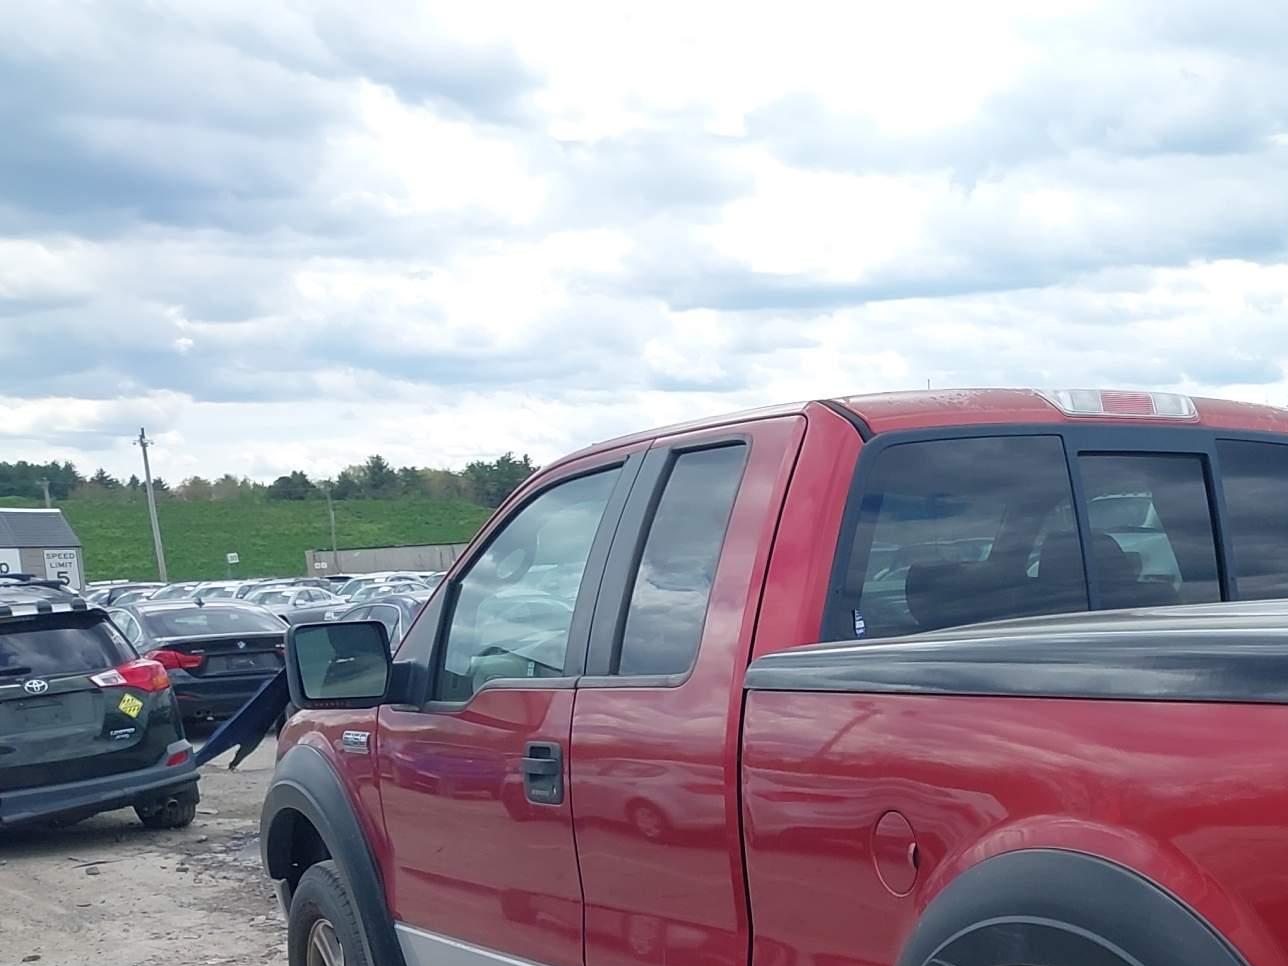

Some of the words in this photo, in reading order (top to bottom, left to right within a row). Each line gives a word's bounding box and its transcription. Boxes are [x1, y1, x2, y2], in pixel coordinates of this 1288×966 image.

[45, 552, 76, 560] SPEED
[49, 561, 73, 569] LIMIT
[56, 570, 71, 586] 5
